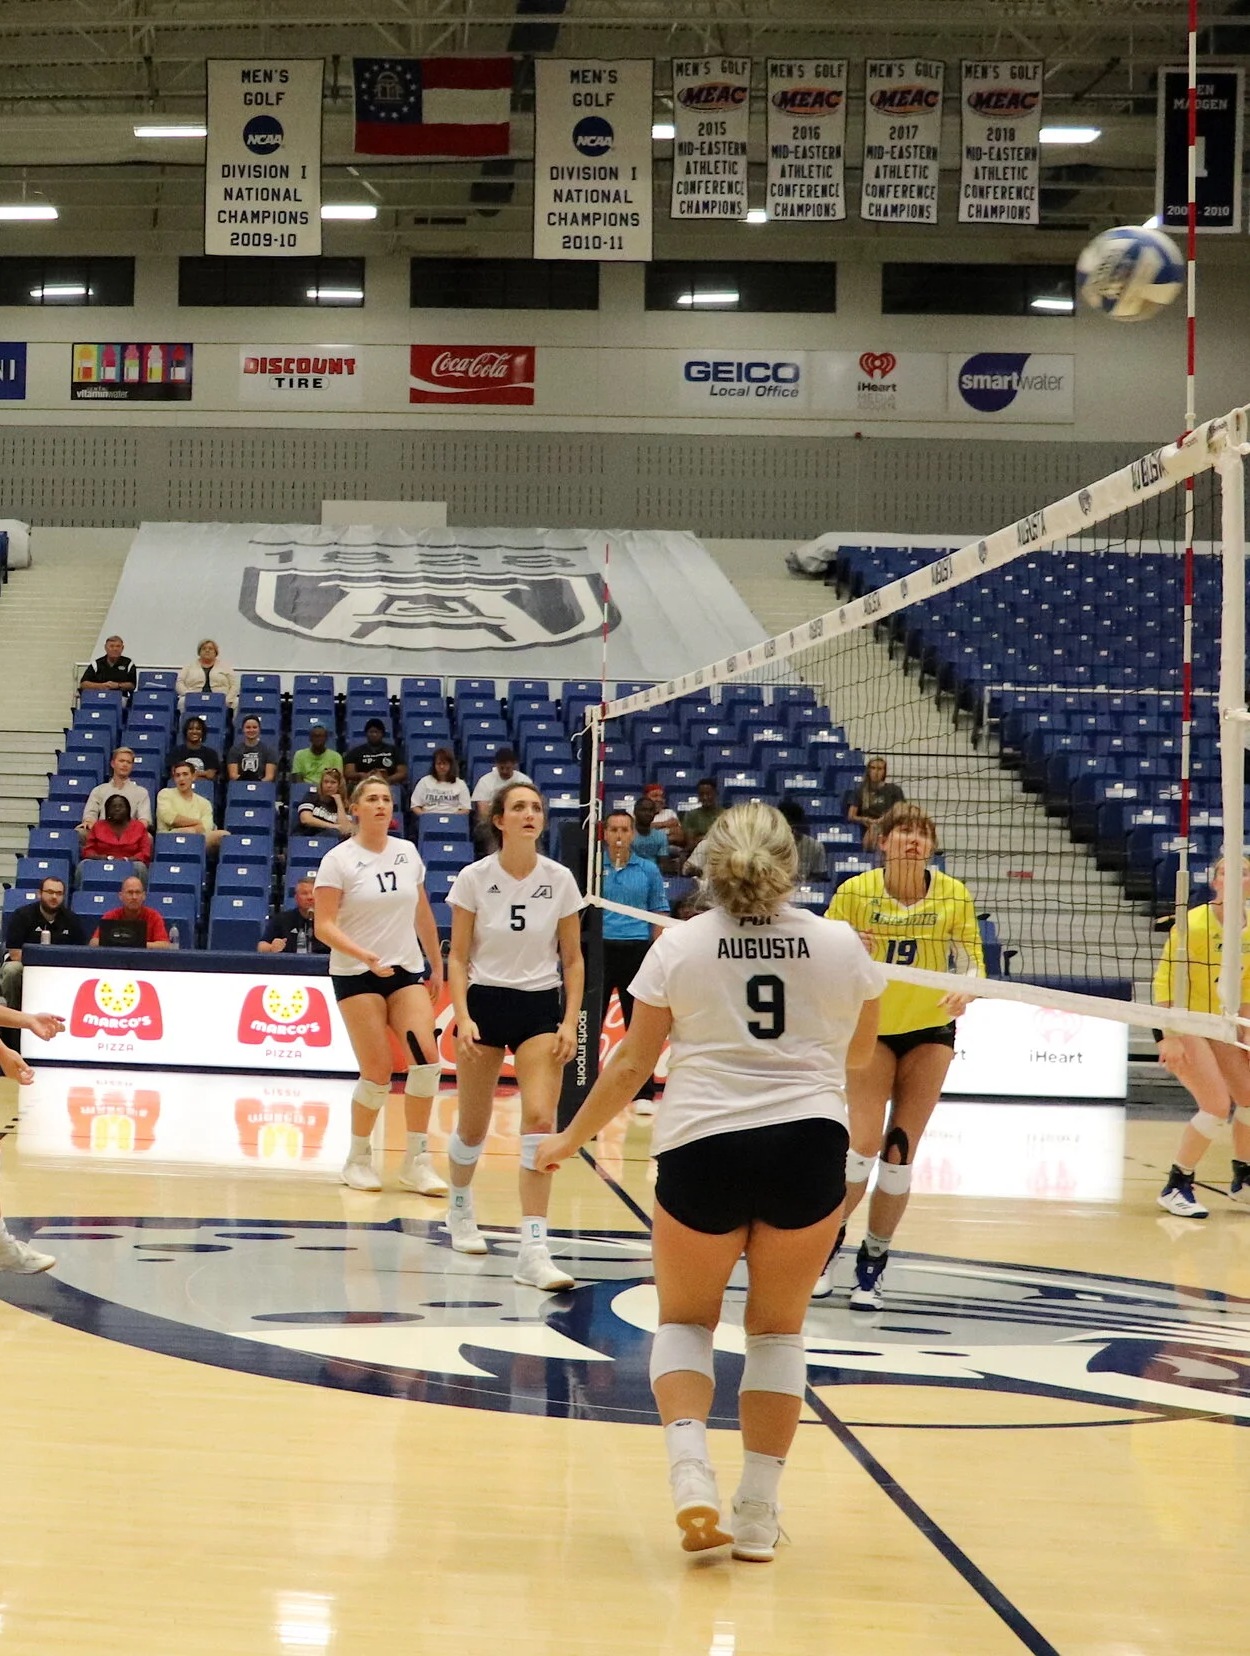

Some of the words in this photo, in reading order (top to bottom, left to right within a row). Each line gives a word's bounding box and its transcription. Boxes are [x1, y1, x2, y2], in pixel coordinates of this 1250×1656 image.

[241, 69, 289, 83] MEN'S
[675, 61, 710, 76] MEN'S
[721, 61, 747, 76] GOLF
[770, 65, 804, 79] MEN'S
[815, 65, 843, 79] GOLF
[869, 63, 905, 78] MEN'S
[915, 63, 943, 78] GOLF
[964, 64, 1000, 79] MEN'S
[1010, 64, 1040, 79] GOLF
[570, 69, 618, 84] MEN'S
[243, 92, 286, 106] GOLF
[572, 93, 615, 107] GOLF
[682, 86, 748, 105] MEAC
[779, 91, 843, 110] MEAC
[876, 89, 939, 108] MEAC
[974, 91, 1040, 110] MEAC
[698, 122, 727, 136] 2015
[792, 125, 821, 141] 2016
[889, 125, 919, 141] 2017
[986, 127, 1016, 142] 2018
[246, 134, 284, 146] NCAA
[576, 135, 614, 148] NCAA
[678, 142, 747, 156] MID-EASTERN
[771, 145, 841, 160] MID-EASTERN
[866, 145, 938, 161] MID-EASTERN
[966, 146, 1037, 161] MID-EASTERN
[221, 164, 290, 180] DIVISION
[301, 164, 307, 180] I
[550, 166, 619, 181] DIVISION
[630, 166, 637, 181] I
[685, 160, 738, 176] ATHLETIC
[780, 164, 833, 180] ATHLETIC
[874, 164, 929, 180] ATHLETIC
[973, 166, 1029, 181] ATHLETIC
[224, 187, 302, 202] NATIONAL
[553, 188, 633, 204] NATIONAL
[676, 181, 745, 196] CONFERENCE
[770, 183, 840, 198] CONFERENCE
[865, 184, 935, 201] CONFERENCE
[964, 186, 1035, 201] CONFERENCE
[679, 201, 742, 216] CHAMPIONS
[774, 203, 837, 218] CHAMPIONS
[868, 203, 932, 219] CHAMPIONS
[967, 205, 1031, 220] CHAMPIONS
[1204, 206, 1230, 216] 2010
[217, 210, 309, 226] CHAMPIONS
[547, 212, 640, 227] CHAMPIONS
[230, 232, 297, 247] 2009-10
[562, 235, 624, 251] 2010-11
[243, 356, 356, 376] DISCOUNT
[683, 360, 800, 384] GEICO
[274, 377, 323, 389] TIRE
[857, 380, 897, 392] iHeart
[961, 372, 1063, 392] smartwater
[709, 384, 750, 397] Local
[755, 384, 799, 398] Office
[376, 871, 397, 893] 17
[510, 905, 526, 932] 5
[717, 937, 810, 959] AUGUSTA
[886, 939, 918, 966] 19
[746, 975, 786, 1040] 9
[82, 1012, 152, 1029] MARCO'S
[250, 1019, 320, 1036] MARCO'S
[576, 1010, 588, 1044] sports
[97, 1042, 135, 1052] PIZZA
[265, 1049, 302, 1059] PIZZA
[1029, 1049, 1084, 1064] iHeart
[576, 1046, 588, 1087] imports
